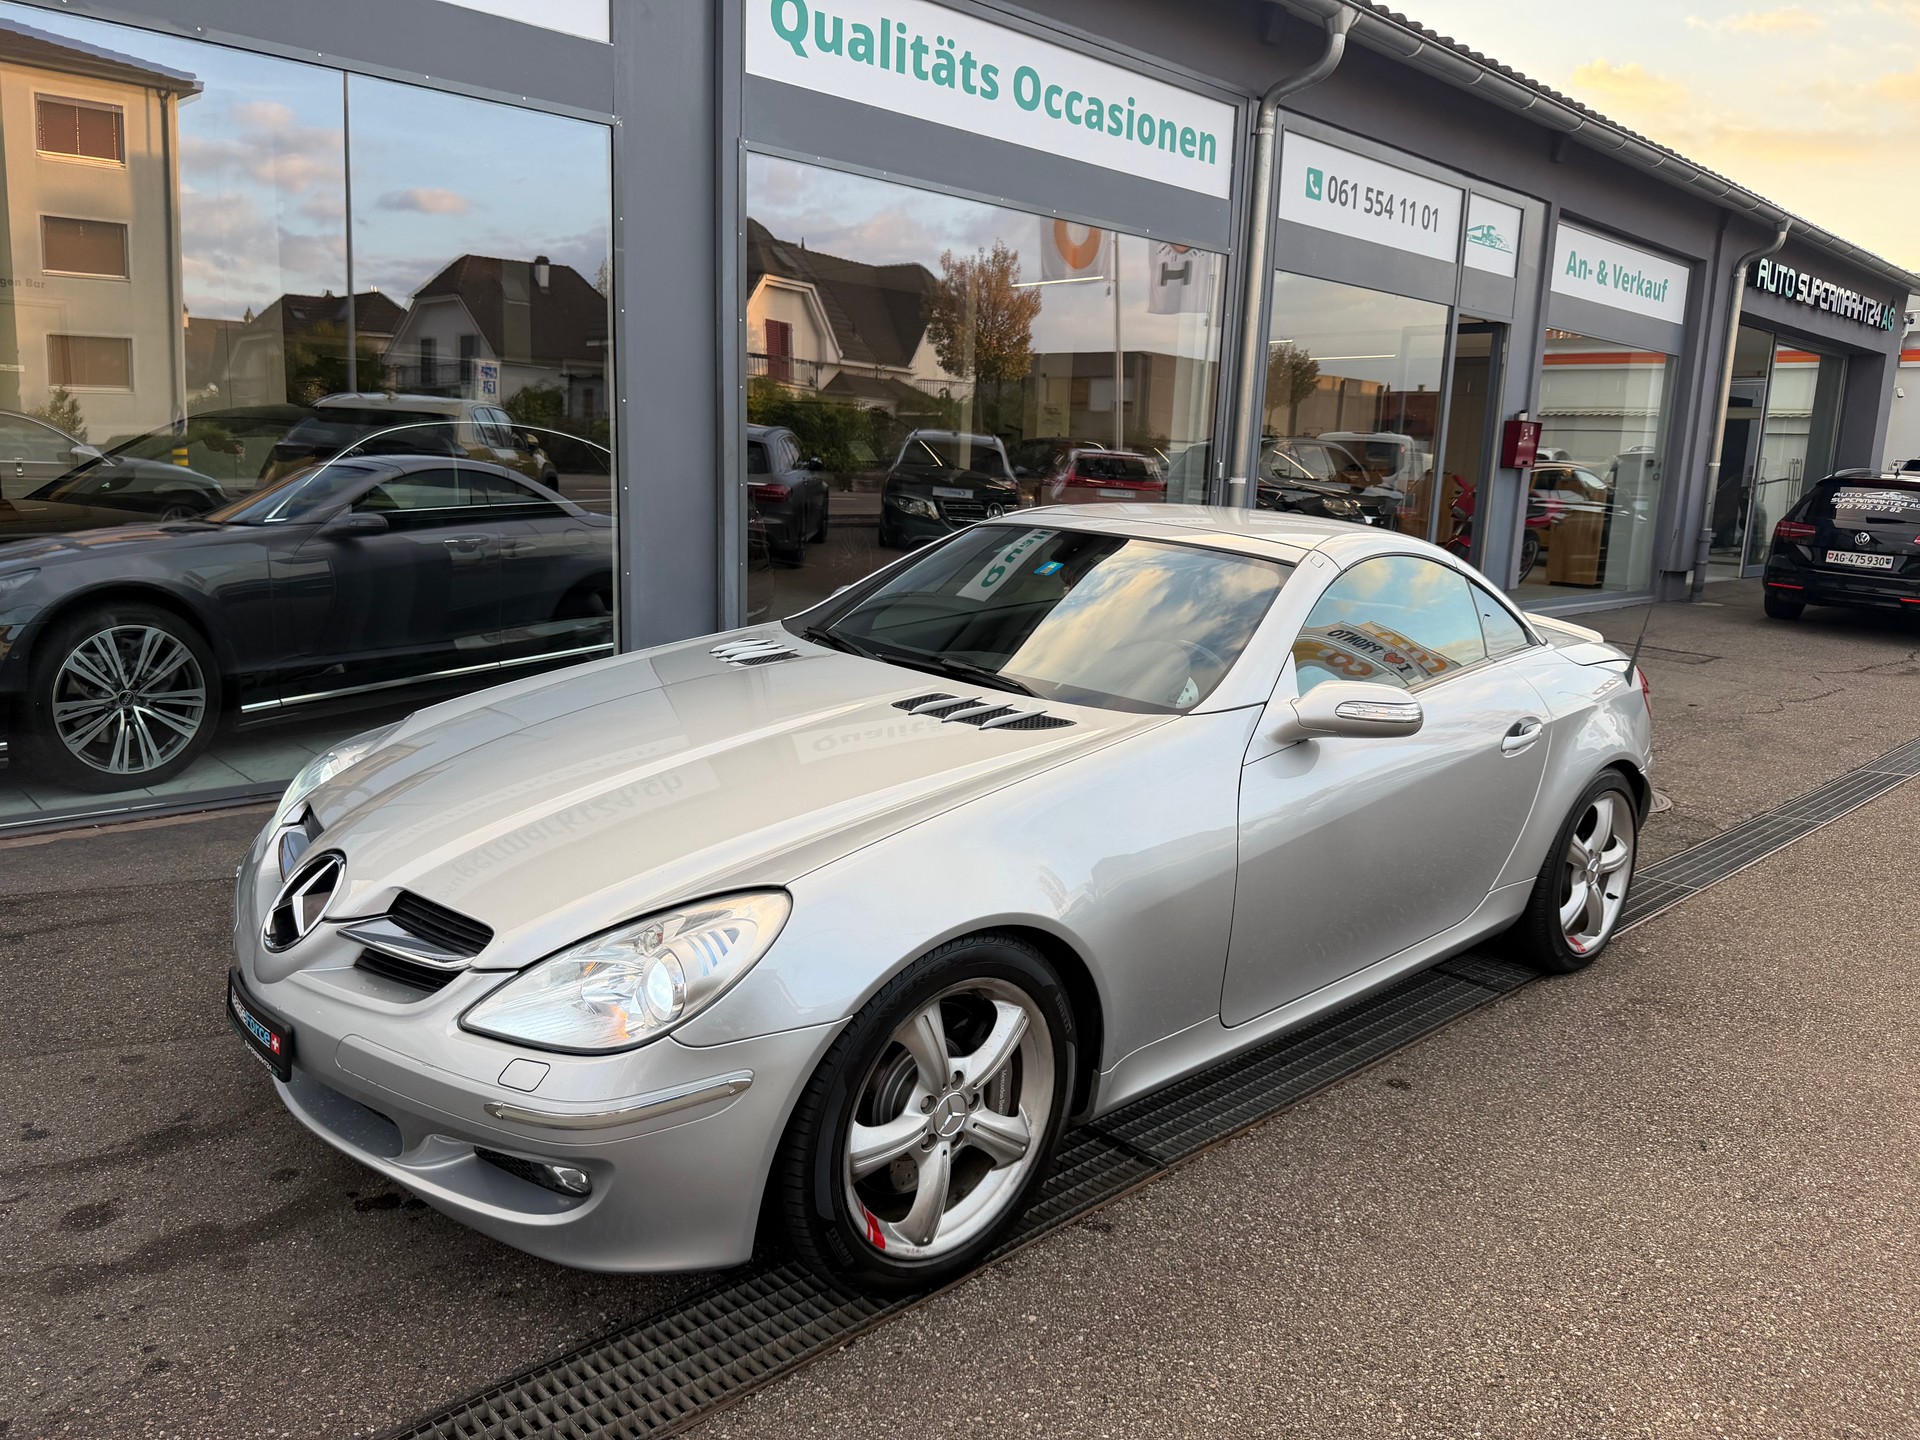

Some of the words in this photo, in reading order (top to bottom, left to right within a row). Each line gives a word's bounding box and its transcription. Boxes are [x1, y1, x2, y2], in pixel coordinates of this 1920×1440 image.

[770, 0, 1000, 101] Qualitäts
[1013, 65, 1217, 165] Occasionen
[1327, 175, 1358, 210] 061
[1363, 186, 1394, 220] 554
[1400, 198, 1416, 227] 11
[1421, 204, 1439, 233] 01
[1565, 250, 1593, 281] An-
[1596, 259, 1609, 287] &
[1613, 263, 1669, 303] Verkauf
[1756, 257, 1797, 299] AUTO
[1880, 304, 1896, 332] AG
